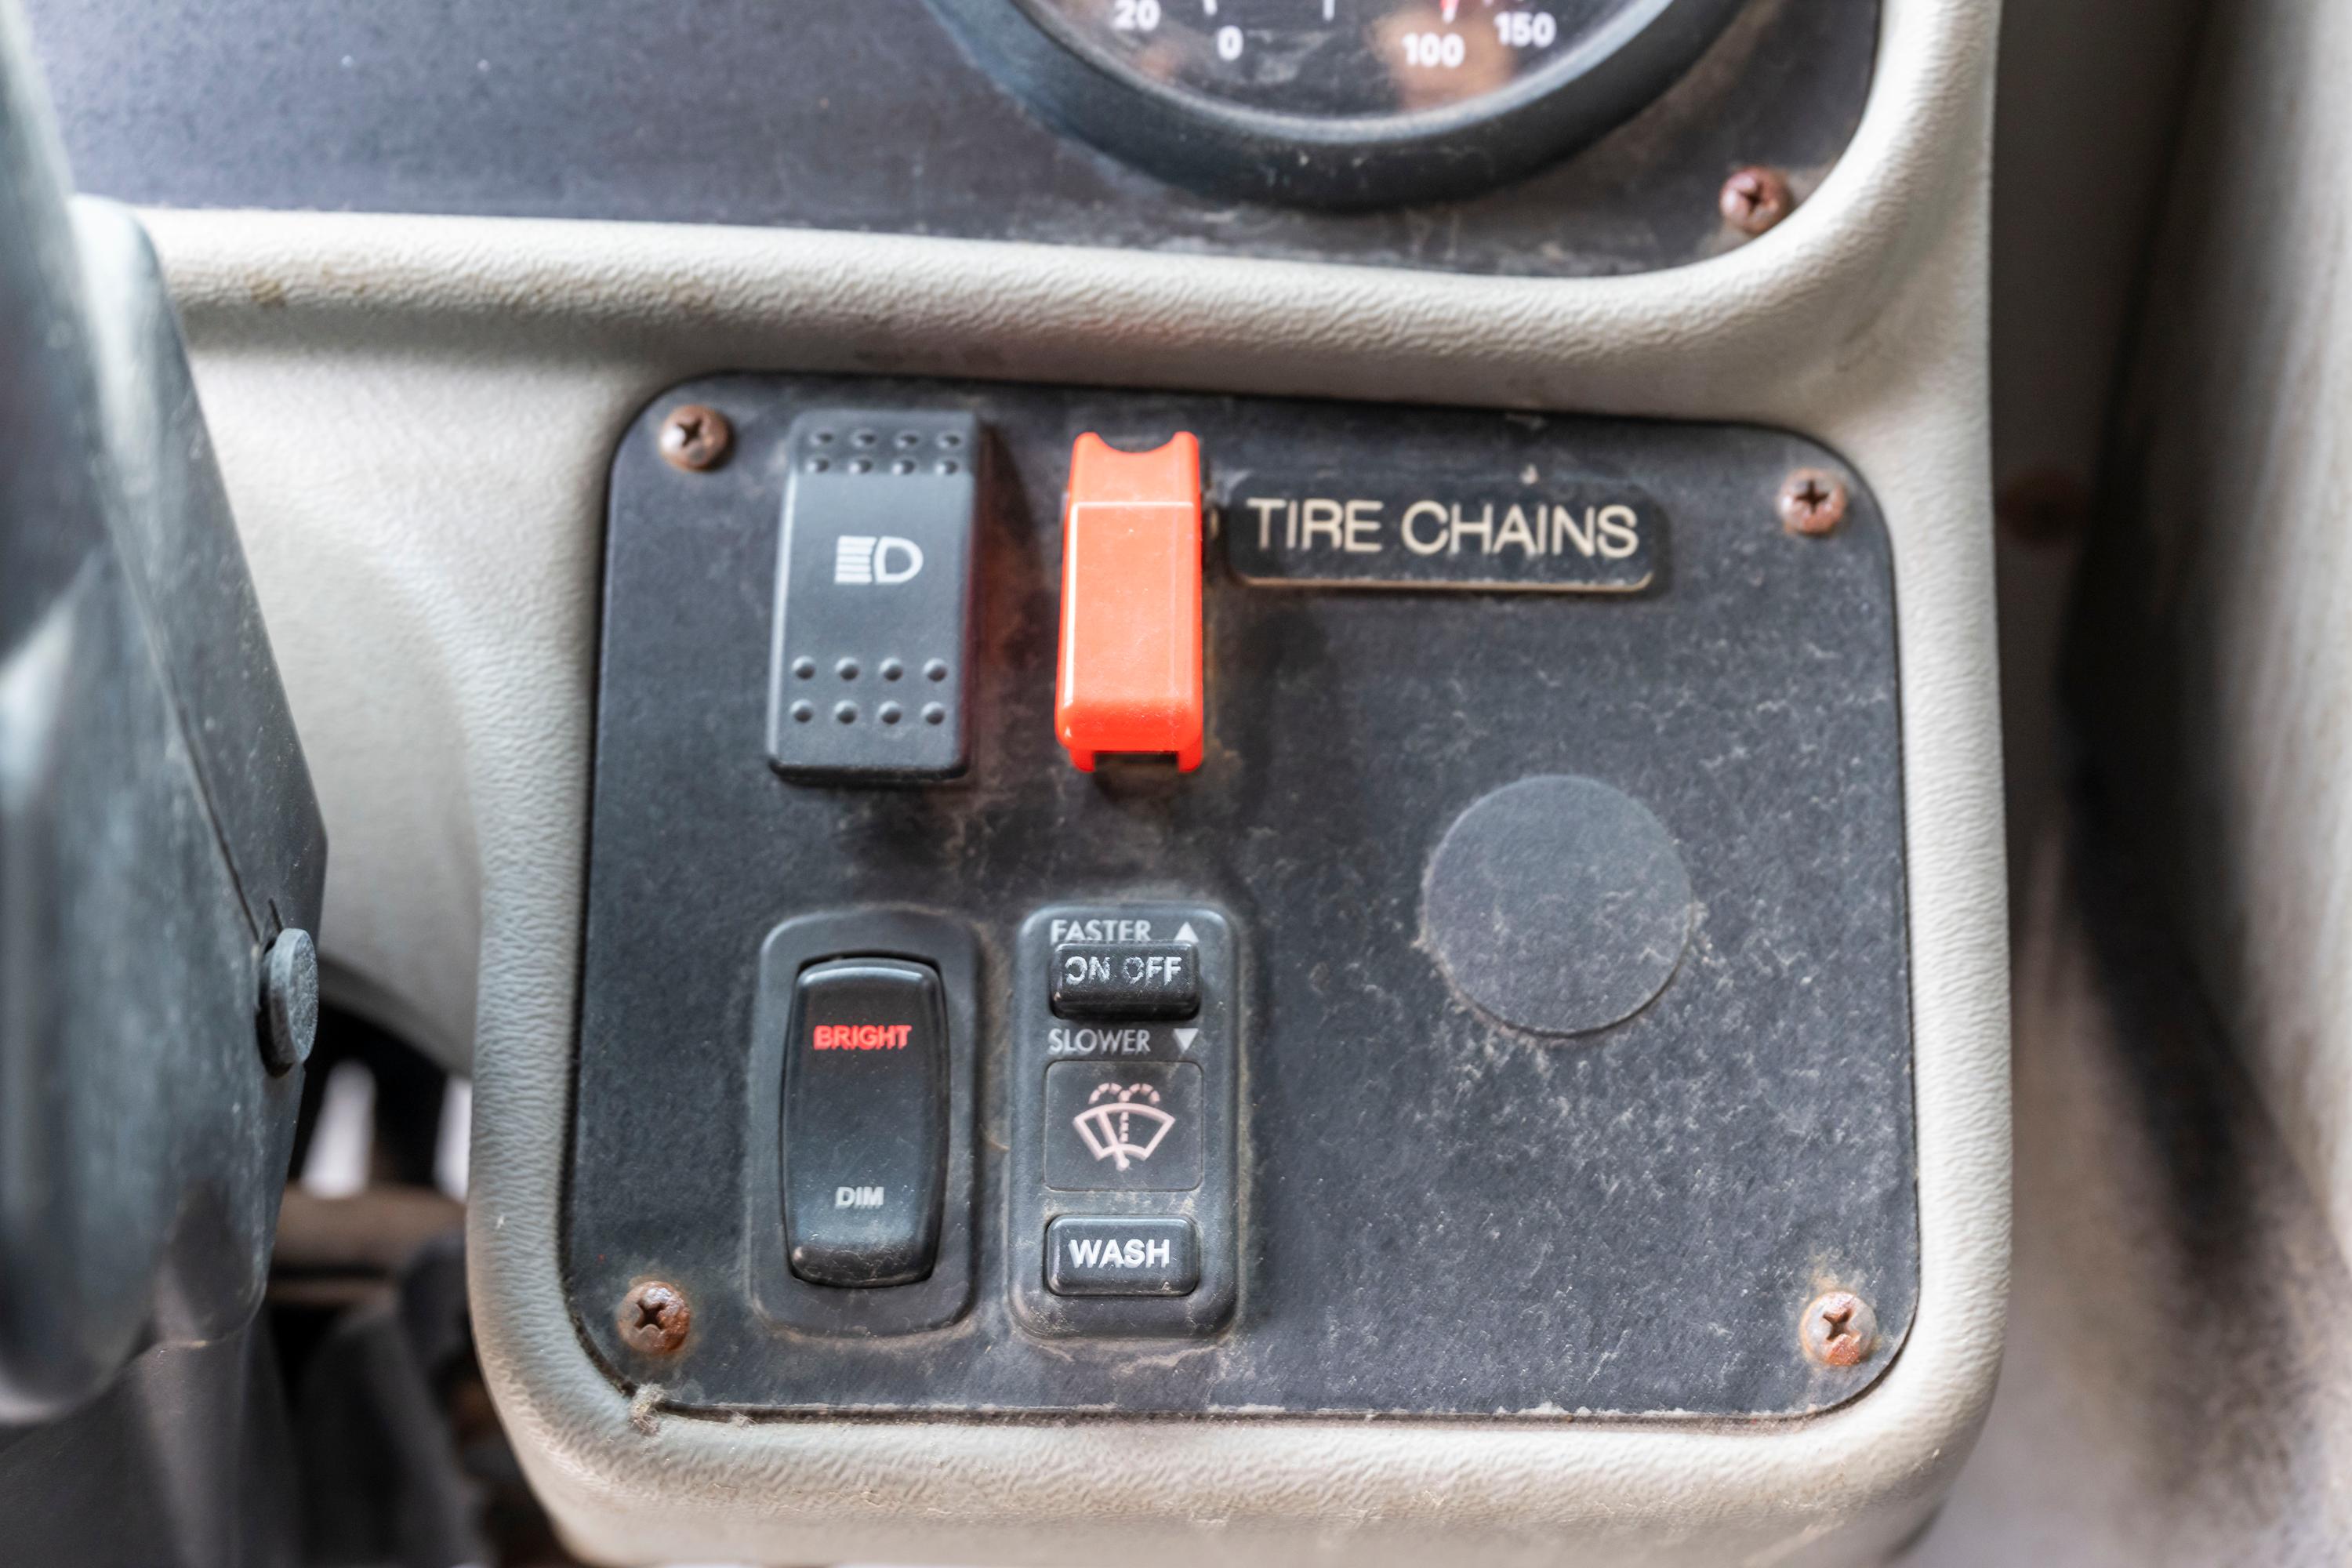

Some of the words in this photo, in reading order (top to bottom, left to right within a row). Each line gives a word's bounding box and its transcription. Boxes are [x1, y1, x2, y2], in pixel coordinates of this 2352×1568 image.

[1112, 0, 1160, 31] 20
[1493, 11, 1556, 47] 150
[1217, 24, 1244, 61] 0
[1402, 32, 1465, 67] 100
[1247, 497, 1384, 553] TIRE
[1401, 499, 1639, 558] CHAINS
[1050, 919, 1152, 945] FASTER
[1064, 955, 1112, 985] ON
[1122, 956, 1182, 985] OFF
[813, 1025, 913, 1050] BRIGHT
[1047, 1028, 1151, 1055] SLOWER
[835, 1186, 884, 1209] DIM
[1068, 1239, 1170, 1269] WASH
